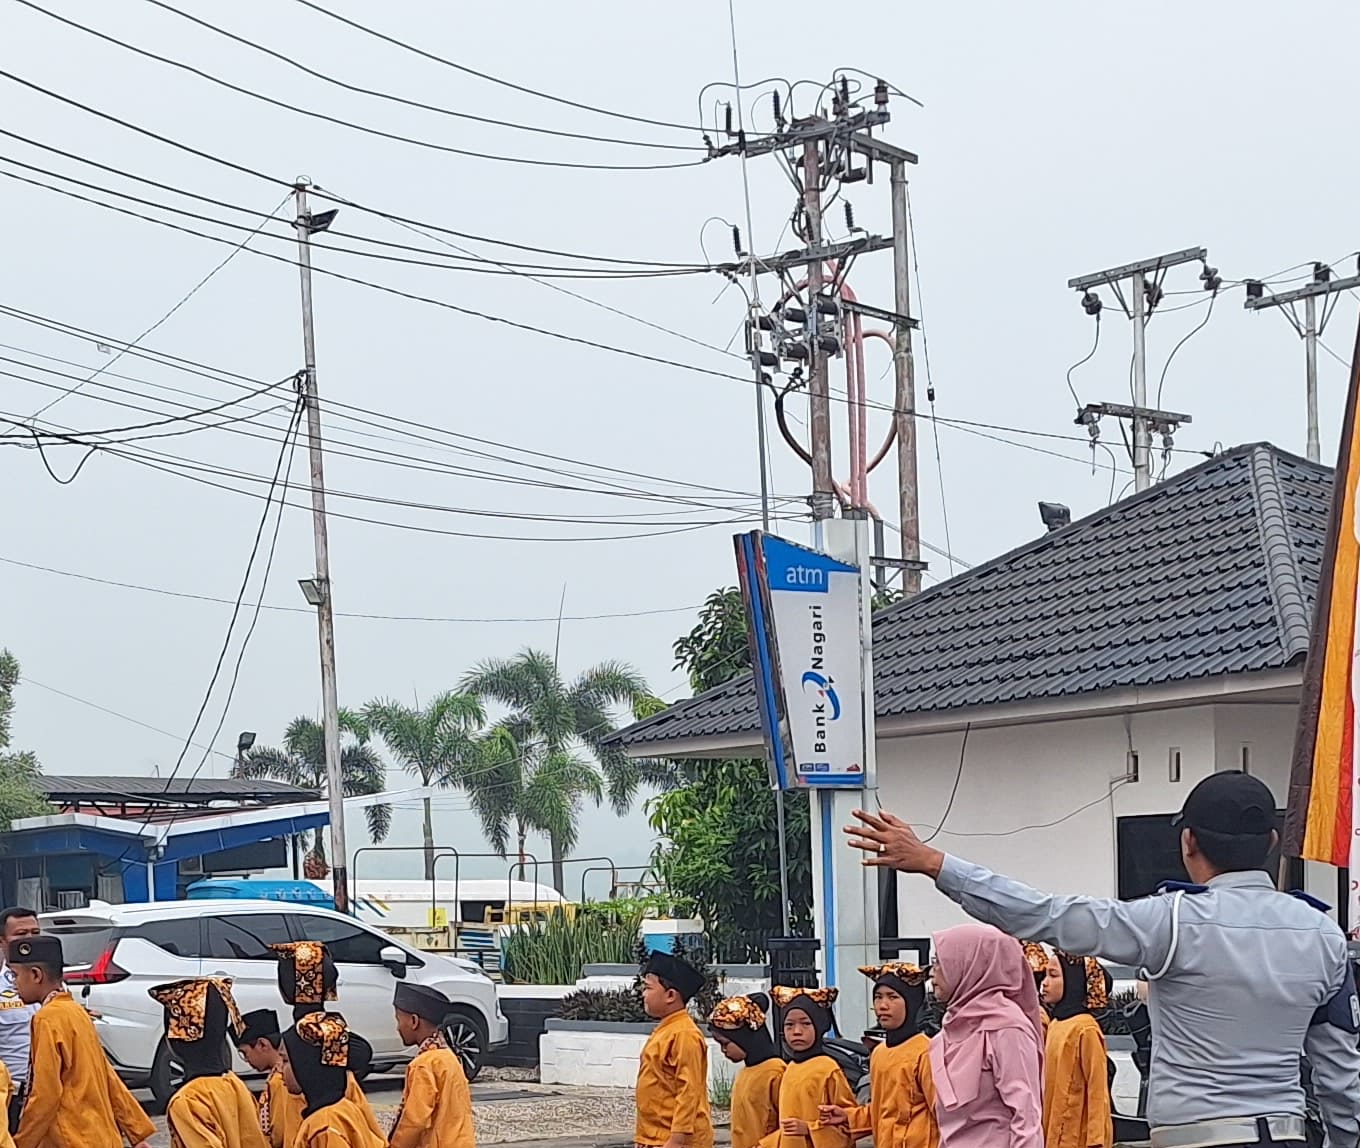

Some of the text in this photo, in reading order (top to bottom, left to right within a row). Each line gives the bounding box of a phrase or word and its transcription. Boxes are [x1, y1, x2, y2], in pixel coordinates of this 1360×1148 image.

[786, 566, 823, 585] atm
[808, 604, 826, 670] Nagari
[811, 703, 827, 754] Bank
